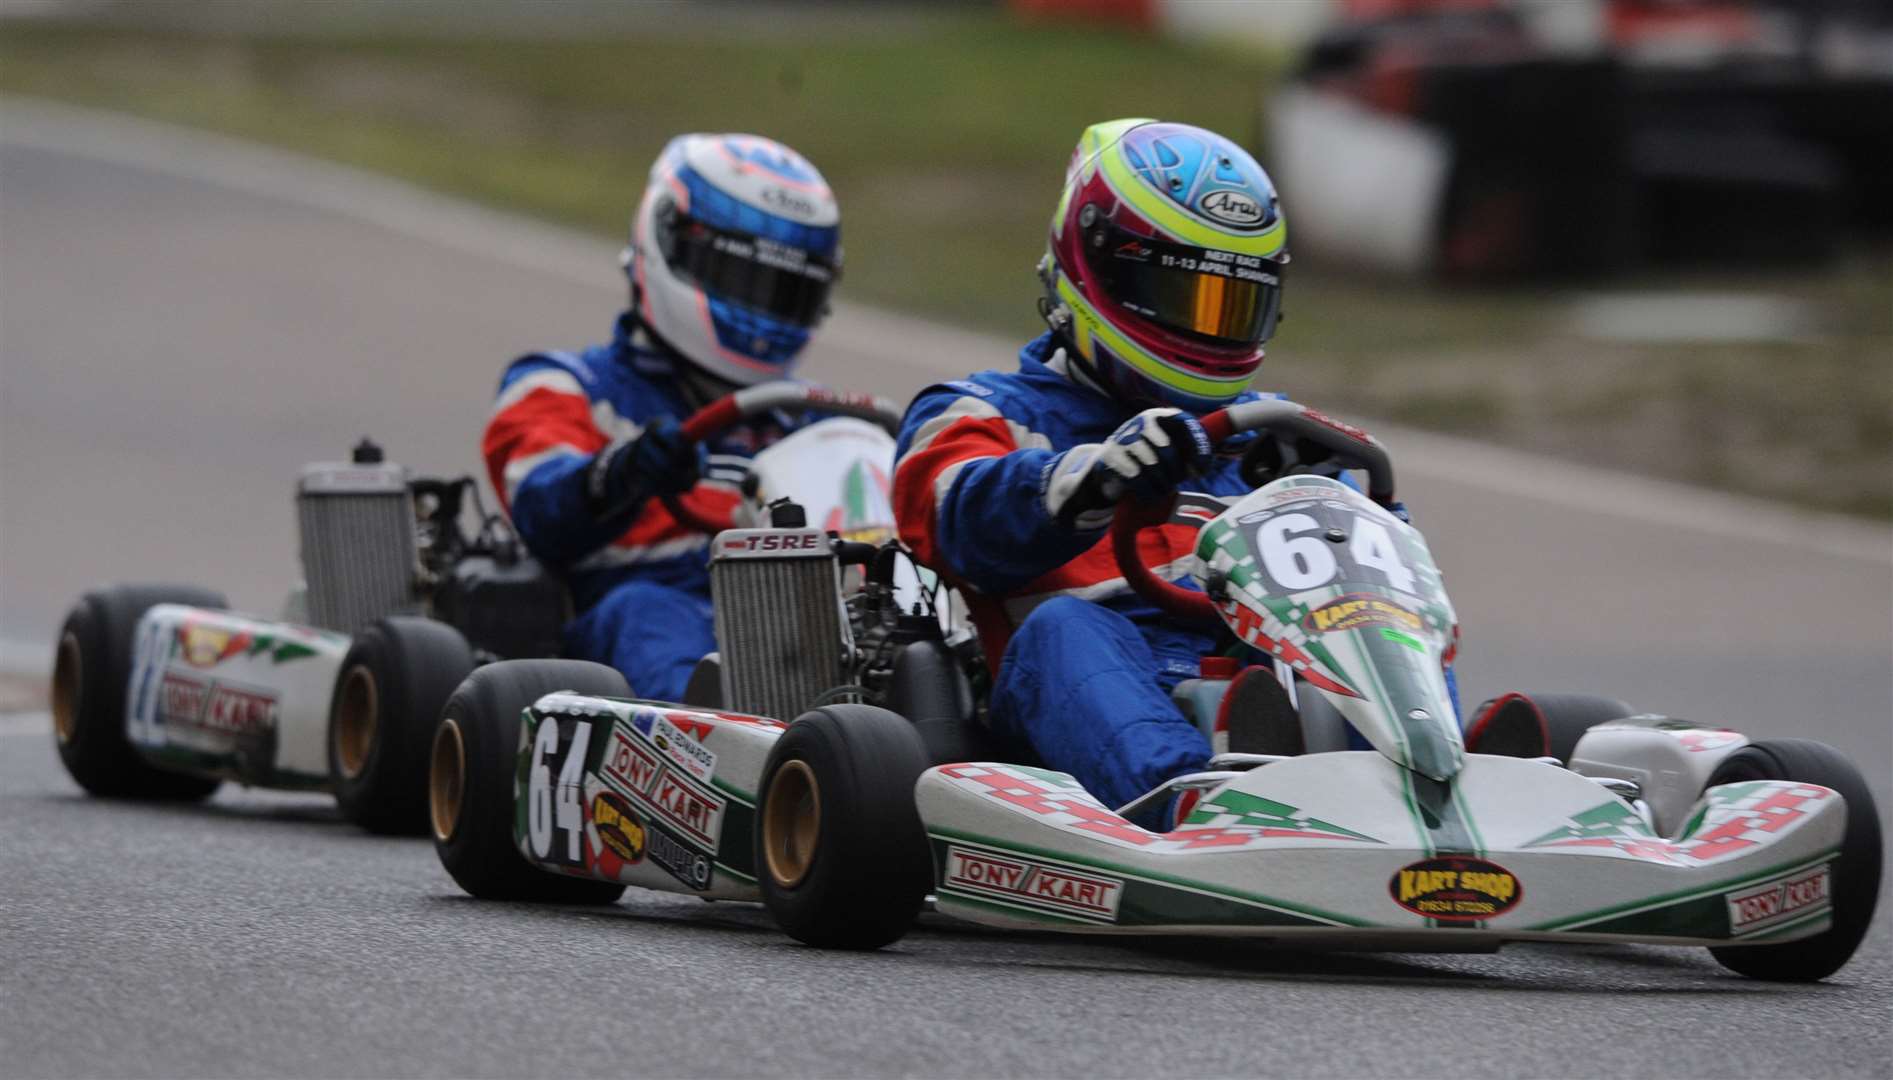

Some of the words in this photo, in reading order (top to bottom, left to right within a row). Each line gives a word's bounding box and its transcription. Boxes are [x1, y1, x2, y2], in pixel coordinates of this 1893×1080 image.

[1211, 193, 1257, 217] Arai
[1161, 255, 1196, 270] 11-13
[1204, 250, 1234, 263] NEXT
[1235, 255, 1261, 268] RACE
[746, 534, 818, 550] TSRE
[1256, 513, 1417, 595] 64
[1312, 600, 1369, 630] KART
[674, 733, 713, 767] EDWARDS
[529, 716, 592, 861] 64
[612, 731, 657, 788] TONY
[660, 771, 719, 833] KART
[954, 852, 1023, 889] TONY
[1038, 871, 1117, 906] KART
[1400, 868, 1458, 902] KART
[1460, 871, 1515, 902] SHOP
